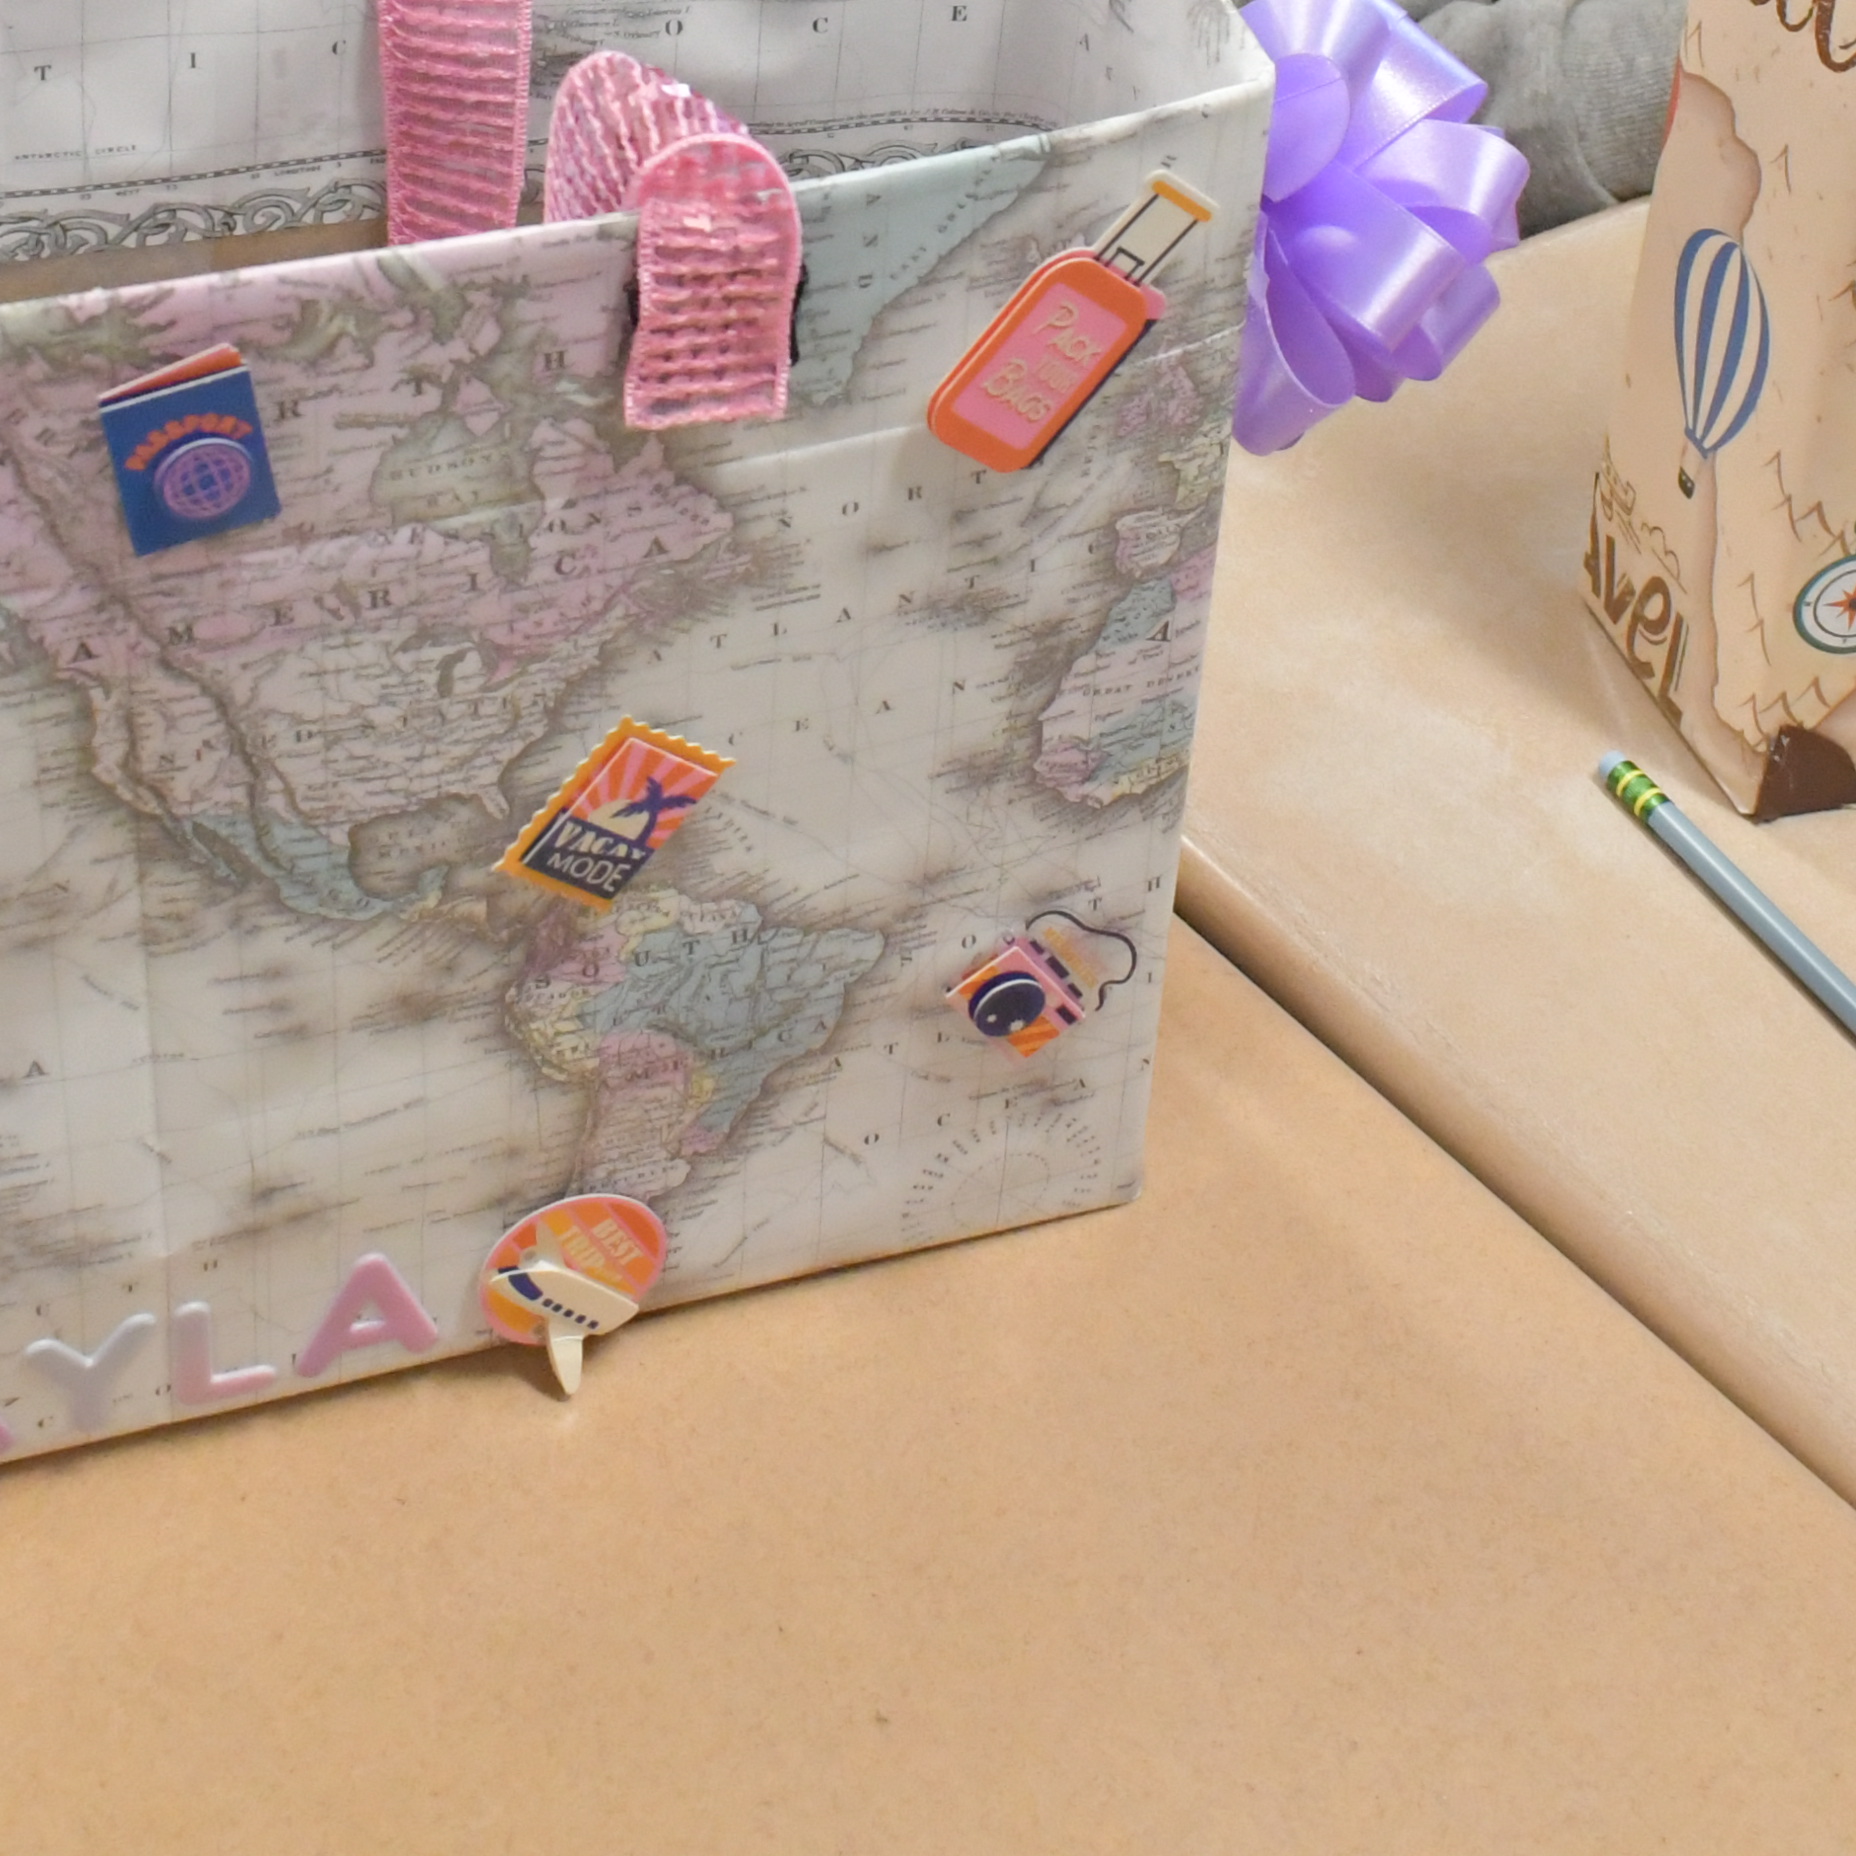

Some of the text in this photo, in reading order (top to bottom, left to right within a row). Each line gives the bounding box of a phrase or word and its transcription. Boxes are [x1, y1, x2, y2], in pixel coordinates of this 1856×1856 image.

[123, 411, 255, 472] PASSPORT
[553, 818, 647, 861] VACAY
[546, 851, 632, 894] MODE
[591, 1217, 645, 1267] BEST
